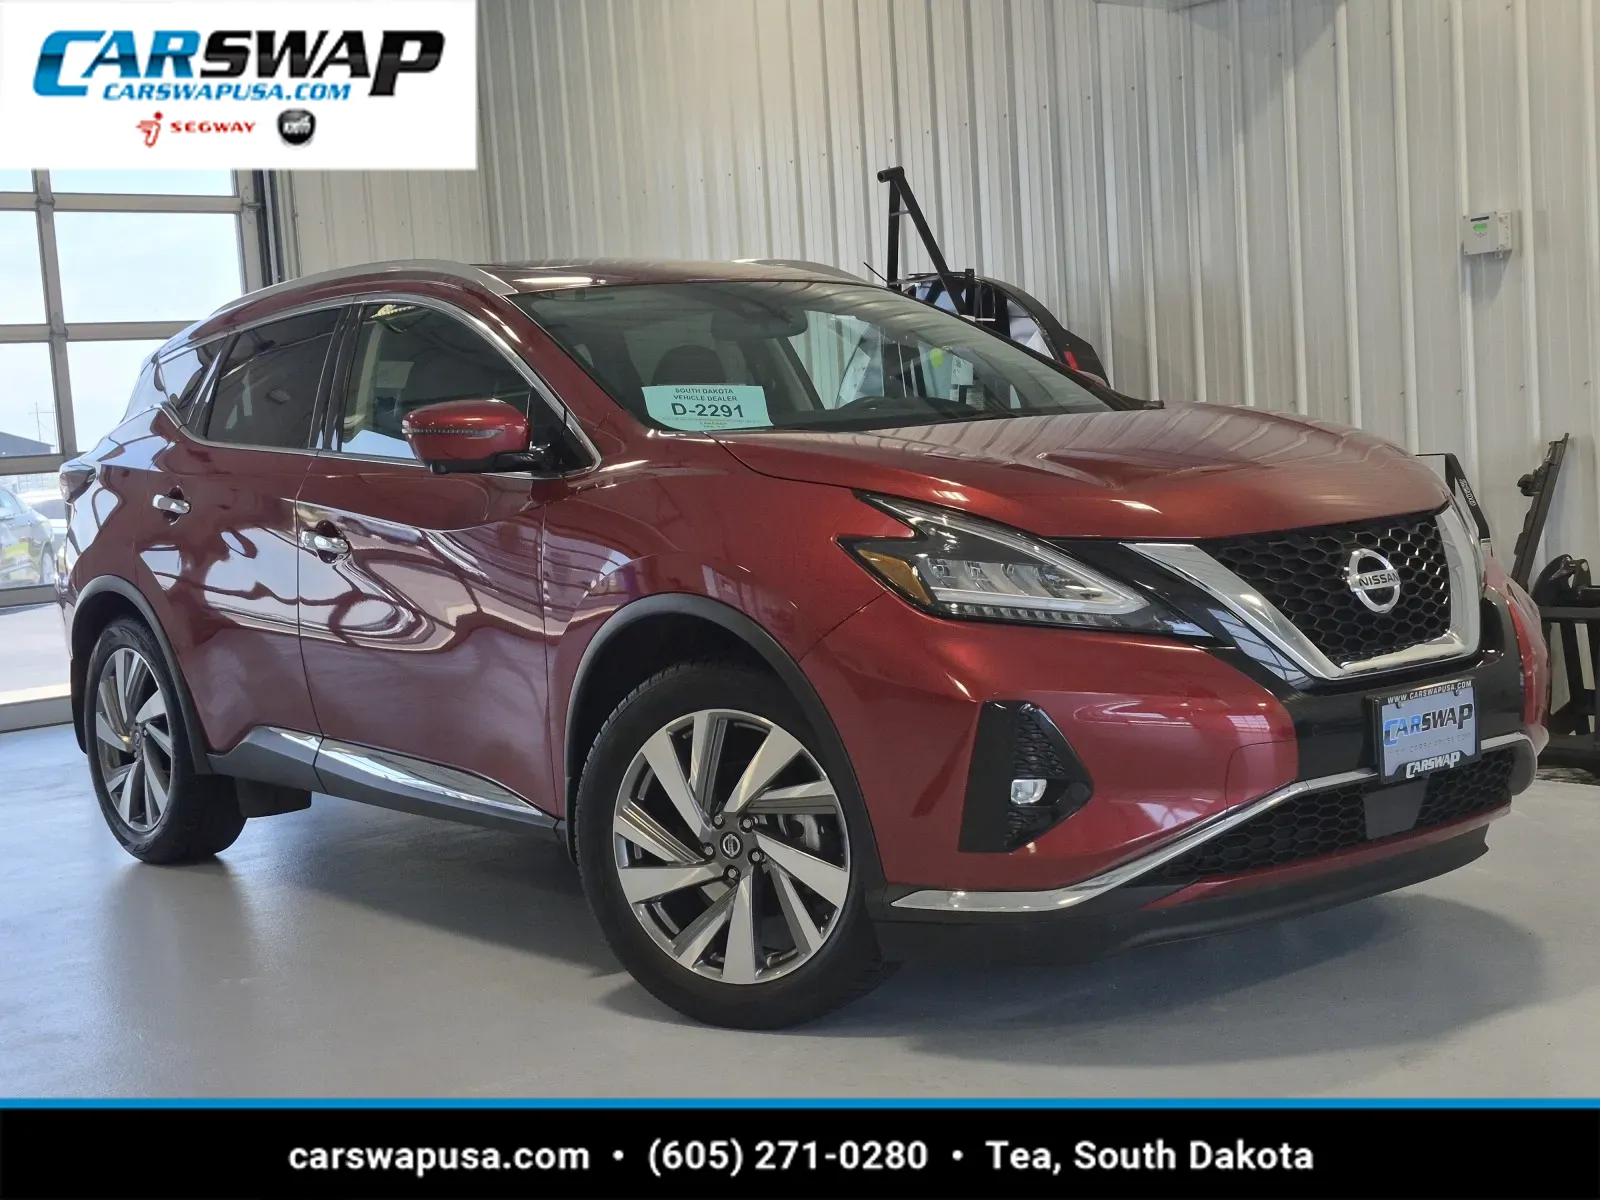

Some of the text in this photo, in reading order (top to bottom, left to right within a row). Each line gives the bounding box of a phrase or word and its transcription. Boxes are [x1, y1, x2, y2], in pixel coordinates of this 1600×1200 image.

[673, 394, 705, 402] VEHICLE
[674, 387, 700, 395] SOUTH
[671, 402, 744, 418] D-2291
[1358, 571, 1400, 587] NISSAN
[1387, 680, 1472, 705] WWW.CARSWAPUSA.COM
[1383, 703, 1474, 747] CARSWAP
[1405, 751, 1461, 779] CARSWAP
